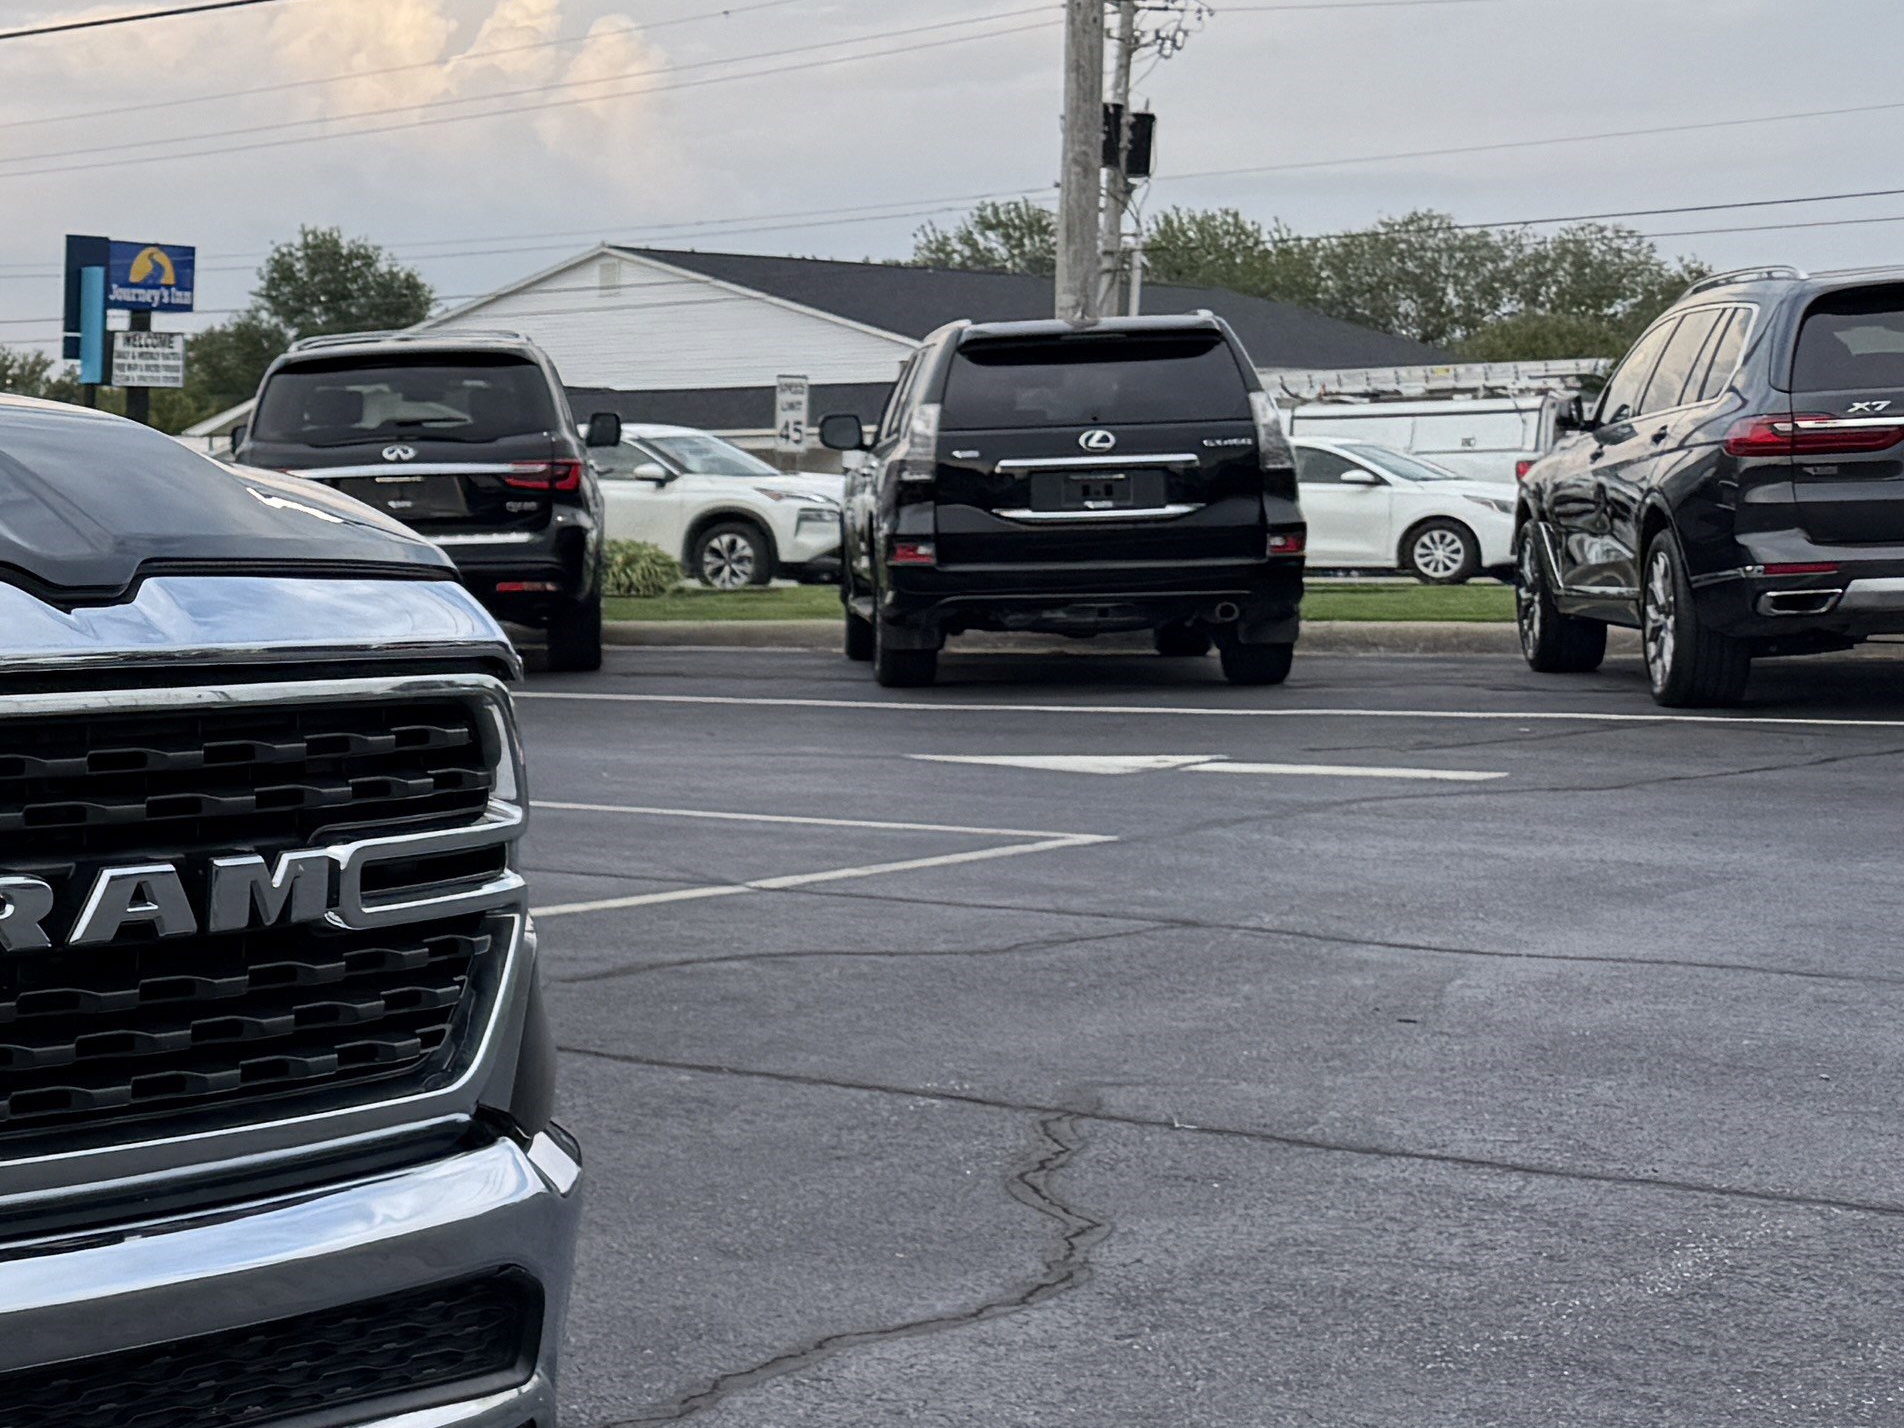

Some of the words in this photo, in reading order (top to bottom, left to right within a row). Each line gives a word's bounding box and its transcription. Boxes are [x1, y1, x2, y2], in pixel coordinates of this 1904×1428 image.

[108, 283, 169, 307] Journey's
[1846, 400, 1892, 413] X7
[779, 420, 802, 444] 45
